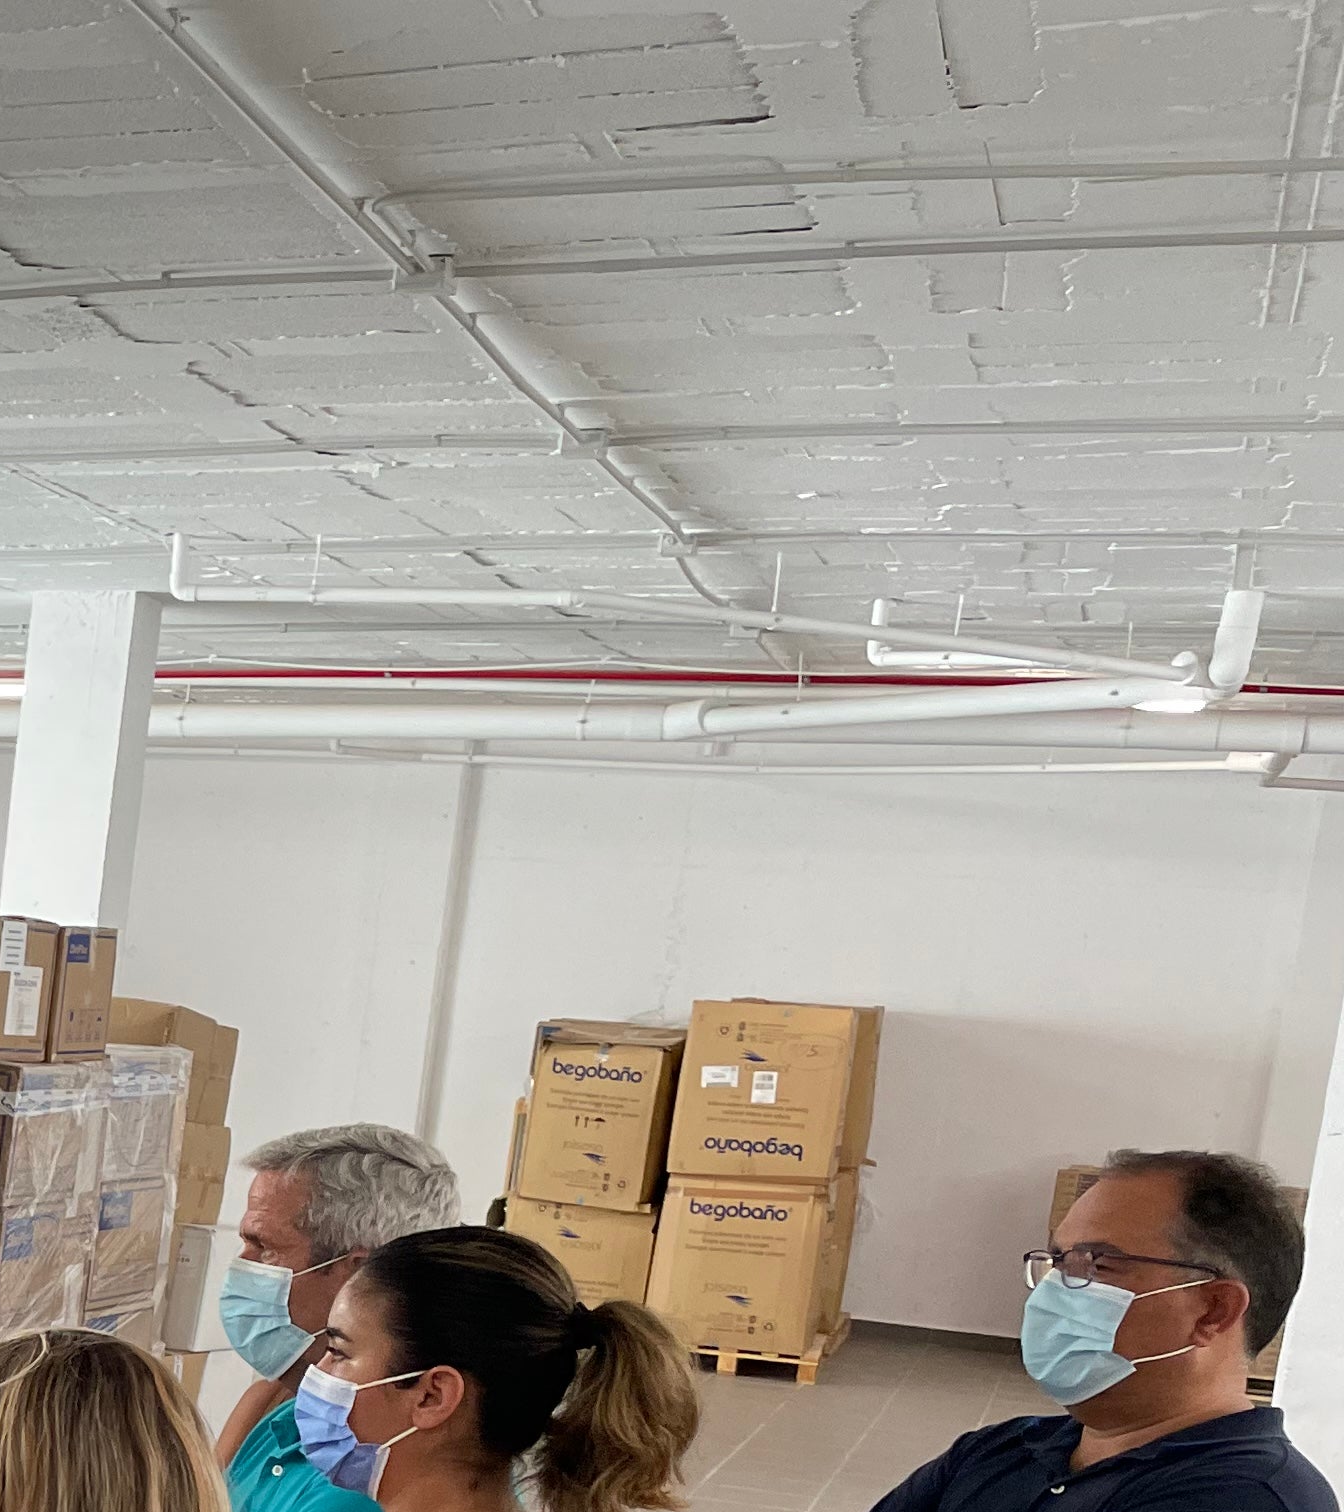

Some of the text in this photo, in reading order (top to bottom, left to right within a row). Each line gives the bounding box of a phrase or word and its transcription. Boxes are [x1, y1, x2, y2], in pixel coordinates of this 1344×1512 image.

[552, 1058, 643, 1083] begobaño
[704, 1137, 803, 1161] begobaño
[689, 1198, 788, 1222] begobaño
